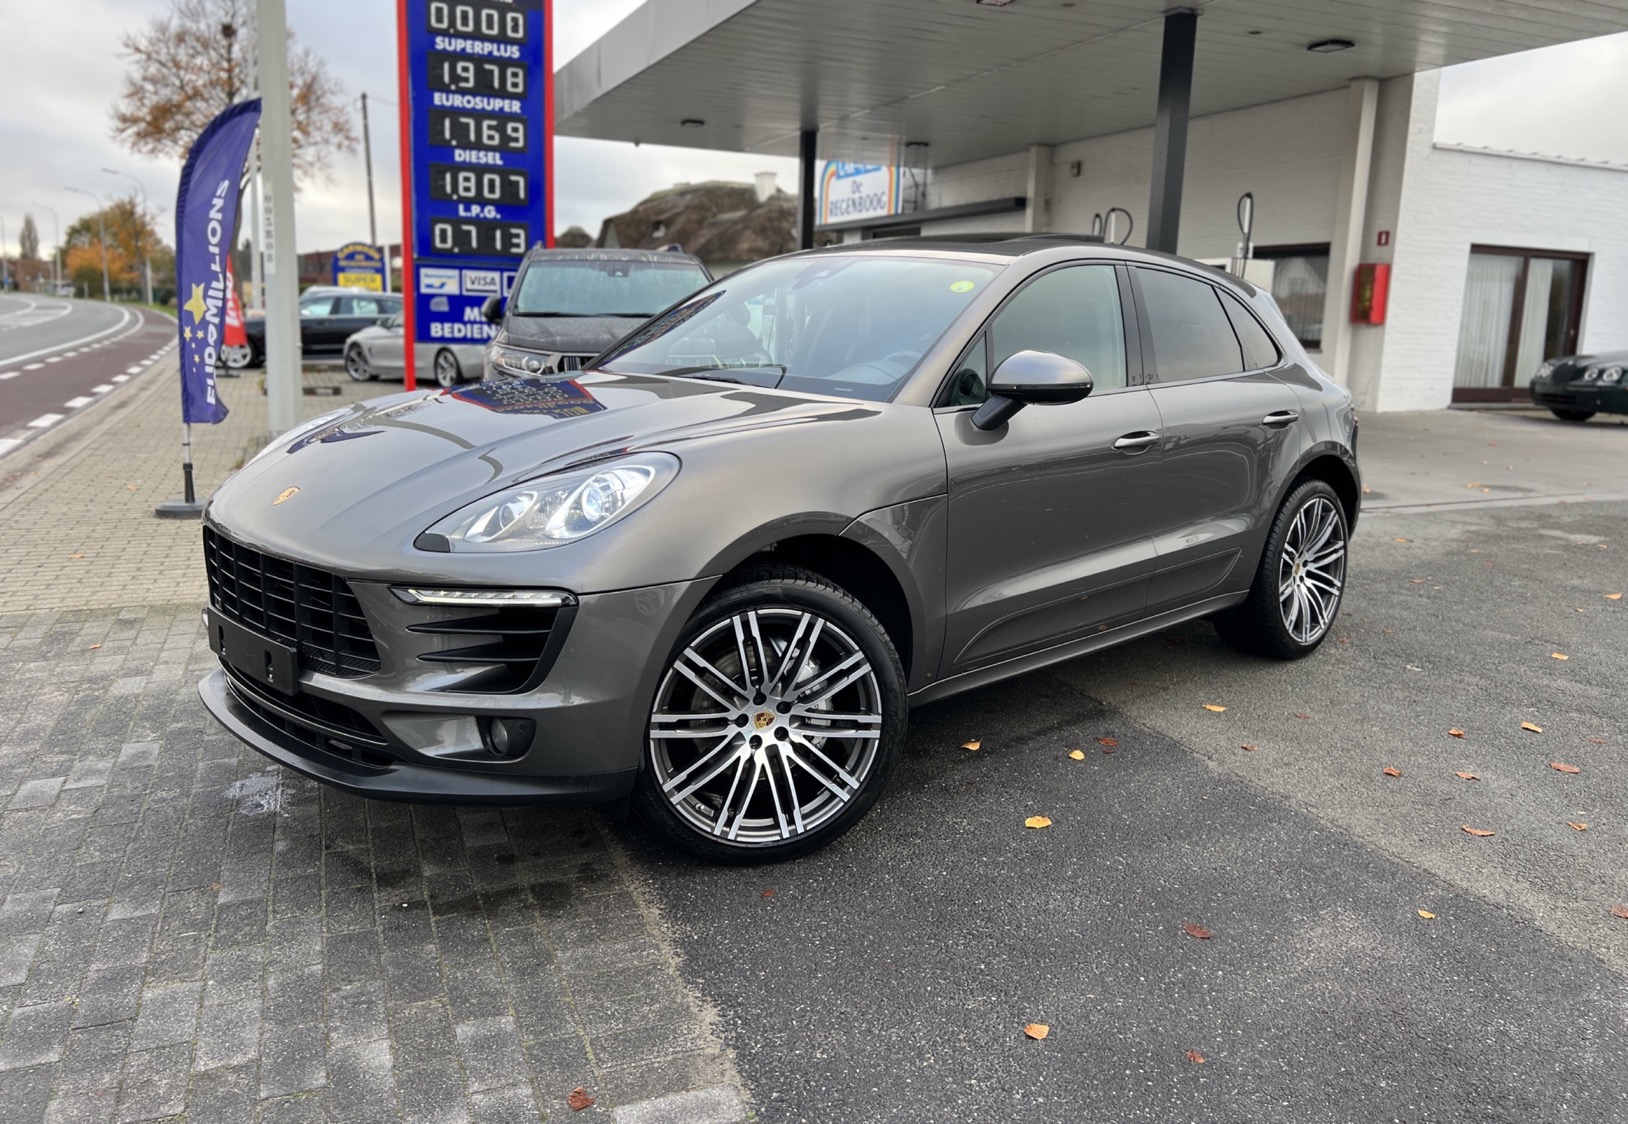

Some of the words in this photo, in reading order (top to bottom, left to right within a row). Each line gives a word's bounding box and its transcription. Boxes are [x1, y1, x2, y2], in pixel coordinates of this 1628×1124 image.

[430, 2, 524, 39] 0.000
[435, 36, 520, 59] SUPERPLUS
[443, 61, 524, 94] 1.978
[433, 92, 521, 113] EUROSUPER
[444, 117, 524, 148] 1.769
[454, 149, 503, 165] DIESEL
[445, 171, 525, 200] 1.807
[458, 204, 501, 219] L.P.G.
[434, 223, 526, 253] 0.713
[469, 275, 496, 287] VISA
[430, 322, 500, 339] BEDIEN
